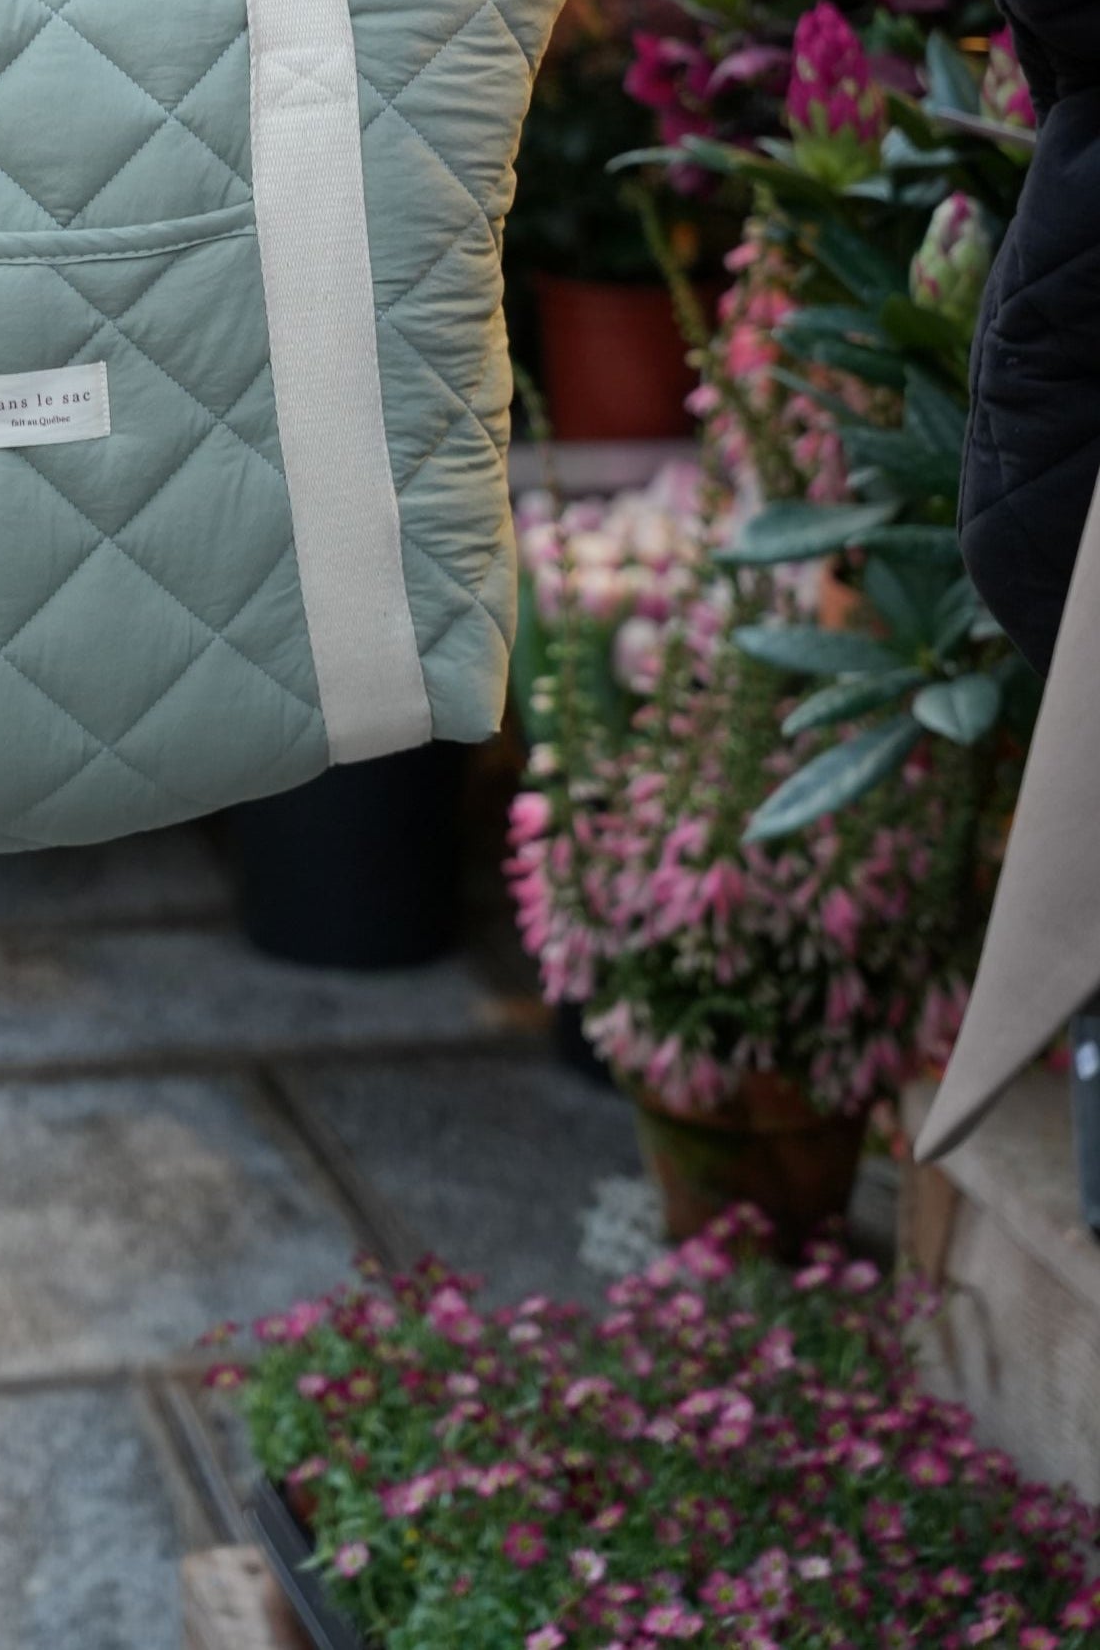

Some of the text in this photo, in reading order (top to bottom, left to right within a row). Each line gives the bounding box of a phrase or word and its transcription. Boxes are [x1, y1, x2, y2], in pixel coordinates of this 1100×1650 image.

[37, 393, 53, 407] le
[62, 391, 91, 404] sac
[11, 418, 25, 427] fait
[39, 415, 71, 427] Québec
